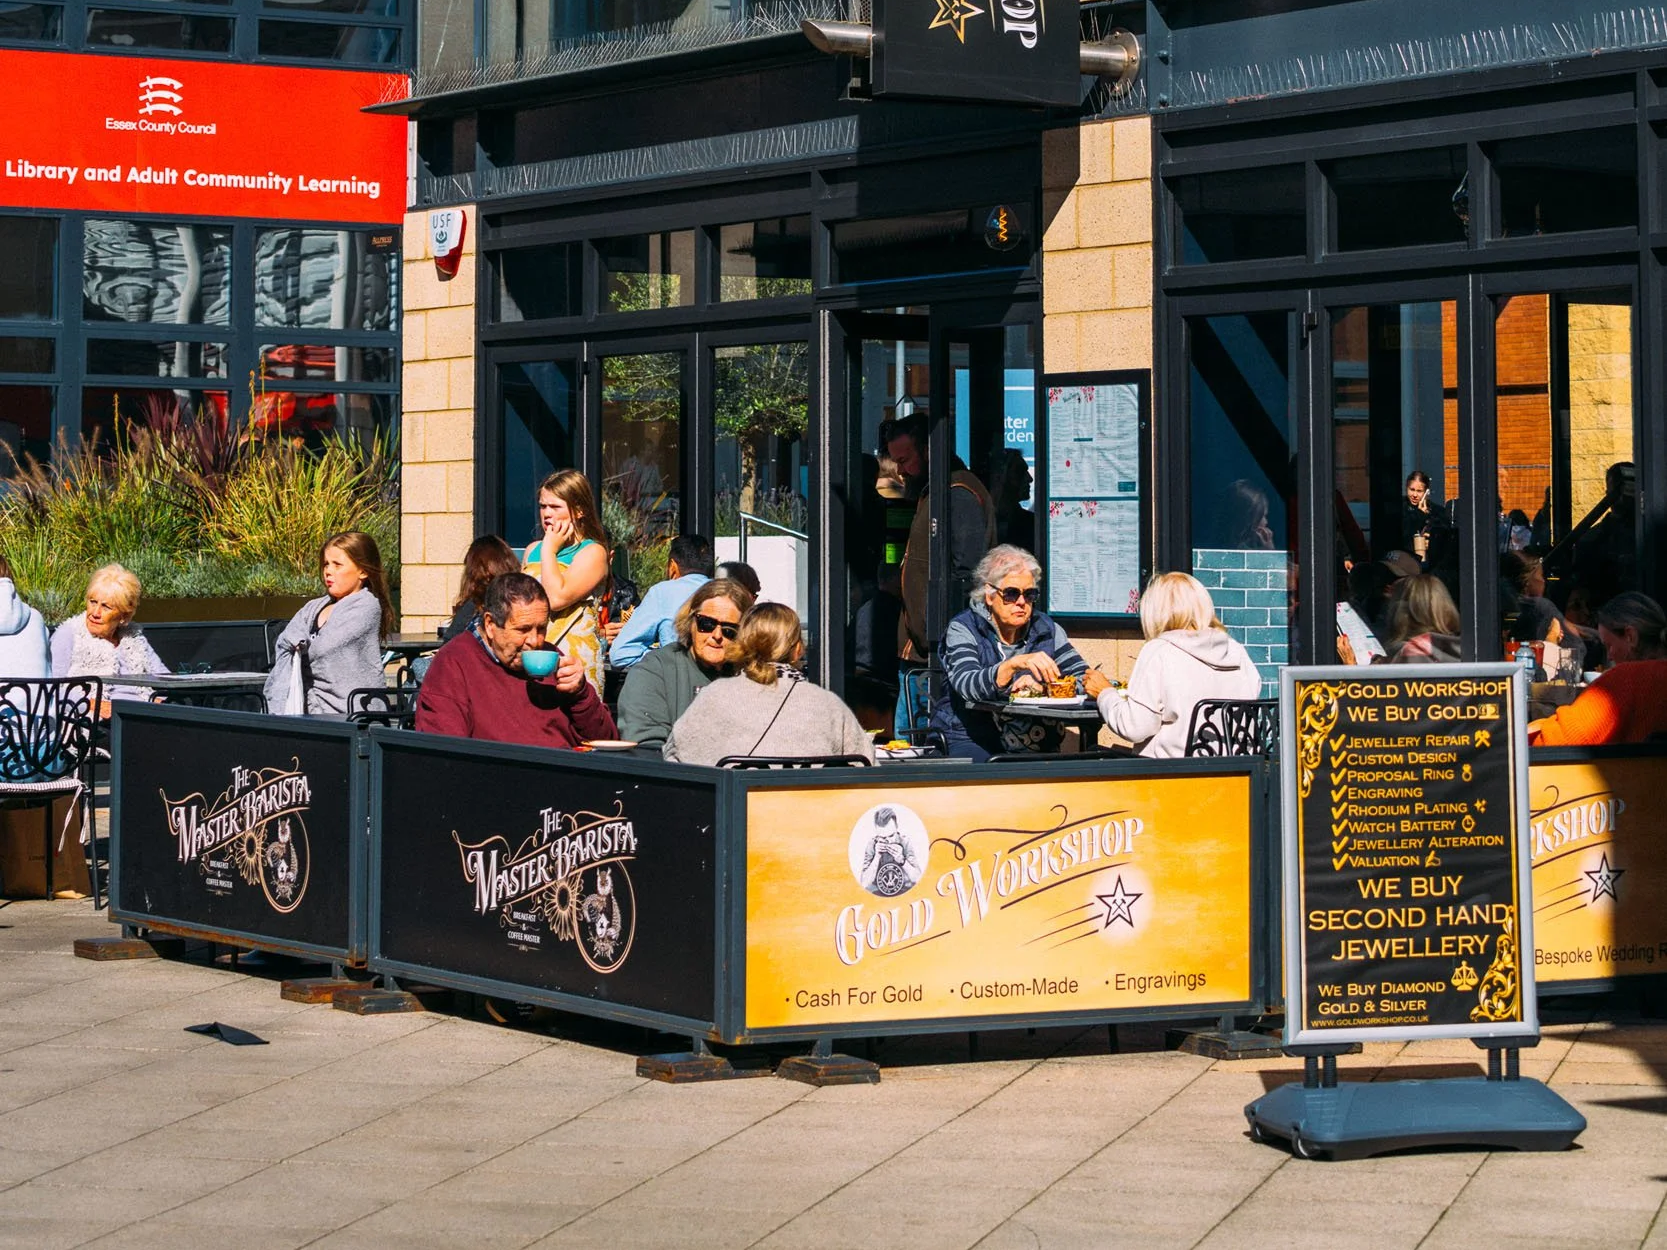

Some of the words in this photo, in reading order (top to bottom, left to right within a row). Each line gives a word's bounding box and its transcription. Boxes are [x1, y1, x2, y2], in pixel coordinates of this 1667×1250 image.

[105, 117, 137, 131] Essex
[138, 119, 177, 136] County
[177, 121, 216, 135] Council
[5, 159, 78, 185] Library
[84, 165, 122, 182] and
[126, 166, 178, 185] Adult
[183, 169, 293, 195] Community
[298, 175, 381, 199] Learning
[432, 213, 451, 229] USF
[1004, 415, 1029, 429] ter
[1004, 429, 1035, 443] den
[1347, 682, 1399, 699] GOLD
[1405, 680, 1508, 698] WORKSHOP
[1347, 706, 1378, 722] WE
[1385, 705, 1421, 721] BUY
[1427, 704, 1479, 720] GOLD
[1346, 736, 1421, 749] JEWELLERY
[1425, 734, 1470, 747] REPAIR
[1347, 753, 1403, 766] CUSTOM
[1408, 752, 1457, 764] DESIGN
[231, 765, 251, 799] THE
[1347, 770, 1419, 783] PROPOSAL
[1423, 768, 1455, 781] RING
[1347, 787, 1424, 800] ENGRAVING
[1348, 804, 1410, 817] RHODIUM
[1415, 802, 1468, 814] PLATING
[172, 805, 242, 865] MASTER
[240, 775, 311, 831] BARISTA
[540, 807, 562, 844] THE
[1348, 821, 1396, 834] WATCH
[1401, 819, 1456, 833] BATTERY
[1349, 838, 1424, 851] JEWELLERY
[1428, 835, 1504, 848] ALTERATION
[467, 849, 553, 916] MASTER
[550, 821, 638, 881] BARISTA
[1349, 855, 1420, 868] VALUATION
[834, 897, 934, 966] GOLD
[935, 816, 1144, 929] WORKSHOP
[1357, 877, 1401, 899] WE
[1411, 875, 1464, 897] BUY
[513, 911, 537, 922] BREAKFAST
[1308, 906, 1426, 931] SECOND
[1436, 903, 1510, 927] HAND
[507, 930, 524, 941] COFFEE
[523, 932, 541, 944] MASTER
[1332, 934, 1490, 961] JEWELLERY
[1535, 947, 1593, 968] Bespoke
[1597, 943, 1654, 964] Wedding
[795, 989, 841, 1008] Cash
[848, 987, 877, 1005] For
[882, 984, 923, 1004] Gold
[960, 977, 1079, 1000] Custom-Made
[1115, 970, 1206, 994] Engravings
[1318, 985, 1342, 997] WE
[1347, 983, 1376, 996] BUY
[1381, 981, 1446, 995] DIAMOND
[1318, 1002, 1360, 1015] GOLD
[1364, 1001, 1375, 1013] &
[1380, 999, 1427, 1013] SILVER
[1311, 1015, 1429, 1028] WWW.GOLDWORKSHOP.CO.UK
